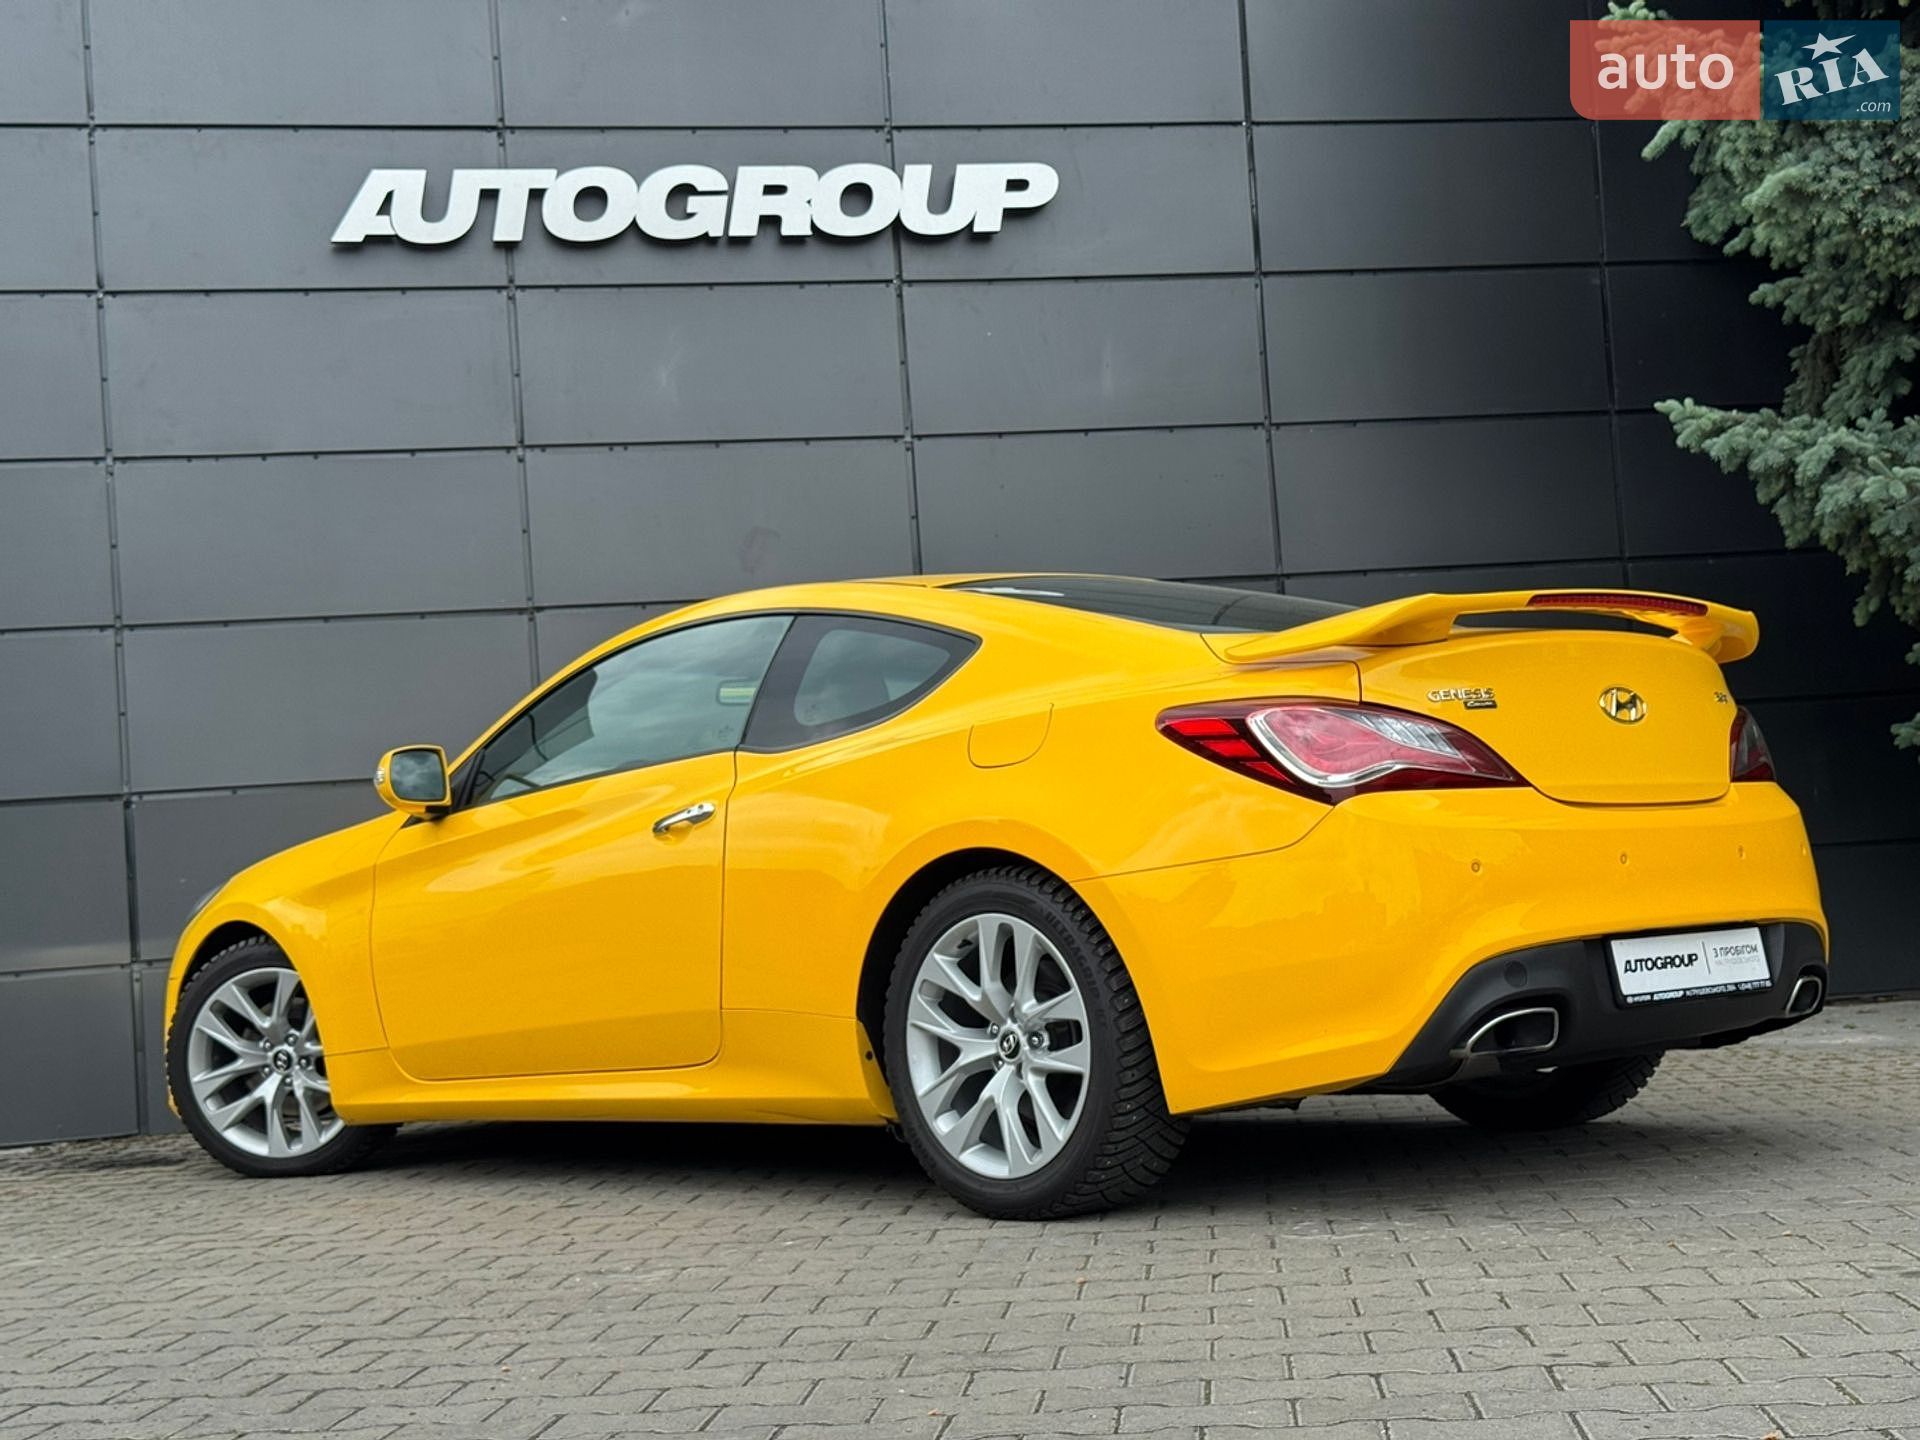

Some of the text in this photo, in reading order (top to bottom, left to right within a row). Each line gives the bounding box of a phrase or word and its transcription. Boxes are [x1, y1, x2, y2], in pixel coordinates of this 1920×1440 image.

[331, 163, 1059, 244] AUTOGROUP
[1427, 688, 1495, 703] GENESIS
[1624, 953, 1699, 975] AUTOGROUP
